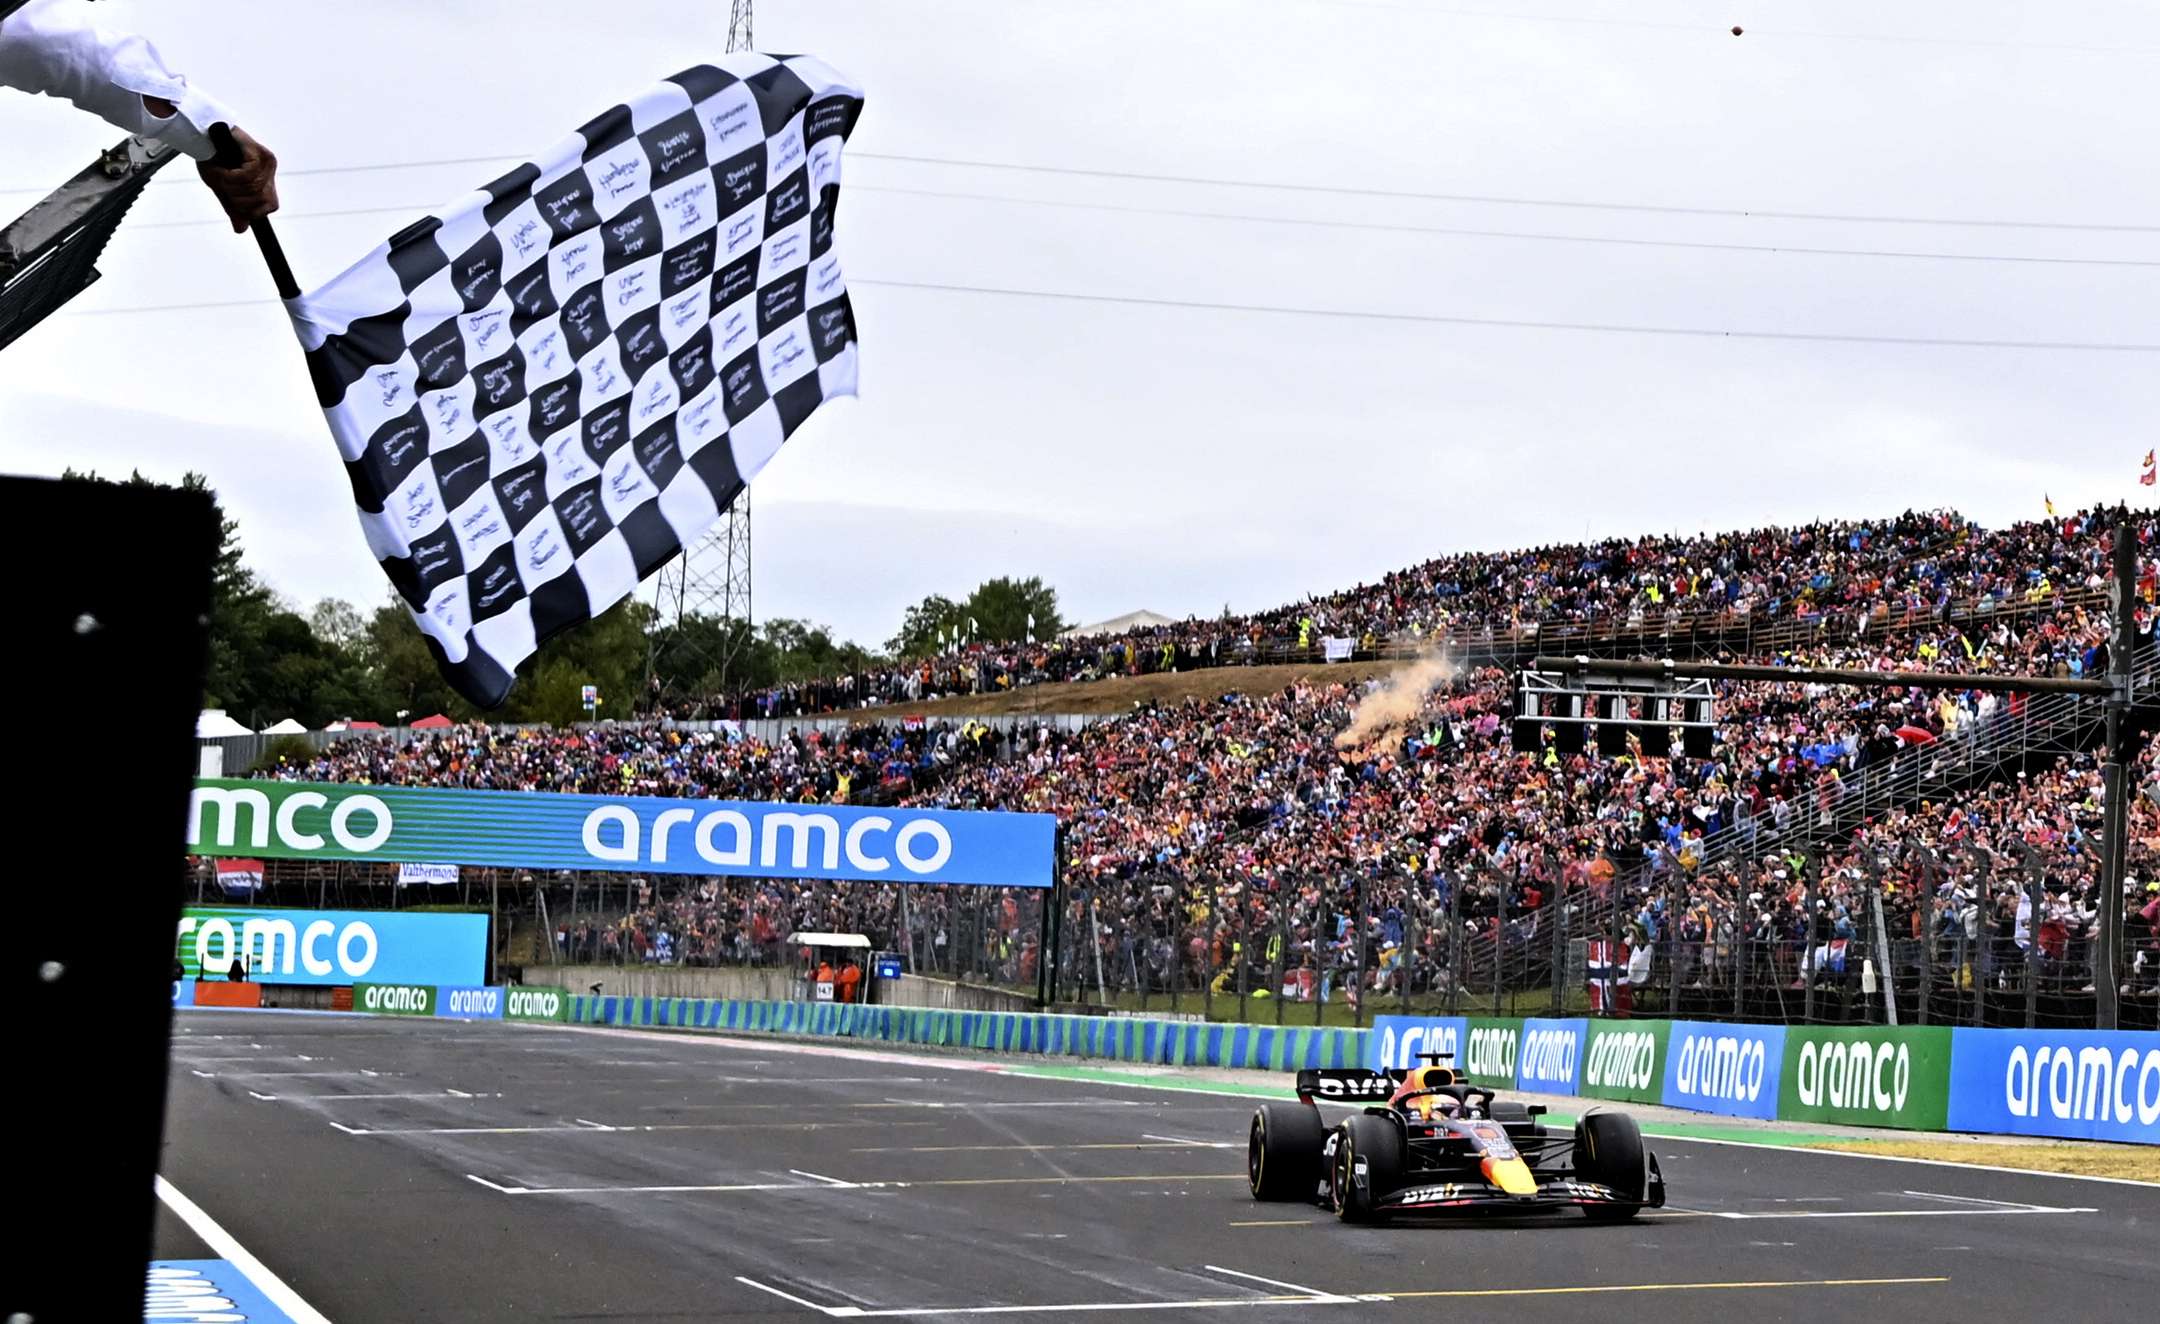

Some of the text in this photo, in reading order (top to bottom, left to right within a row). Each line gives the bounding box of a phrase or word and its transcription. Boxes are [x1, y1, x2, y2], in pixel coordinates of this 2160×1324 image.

[582, 805, 952, 874] aramco
[365, 985, 427, 1012] aramco
[450, 990, 497, 1014] aramco
[508, 991, 559, 1017] aramco
[1468, 1027, 1517, 1079] aramco
[1522, 1029, 1577, 1083] aramco
[1587, 1031, 1655, 1090] aramco
[1676, 1035, 1766, 1102] aramco
[1798, 1040, 1909, 1112] aramco
[2006, 1045, 2160, 1126] aramco
